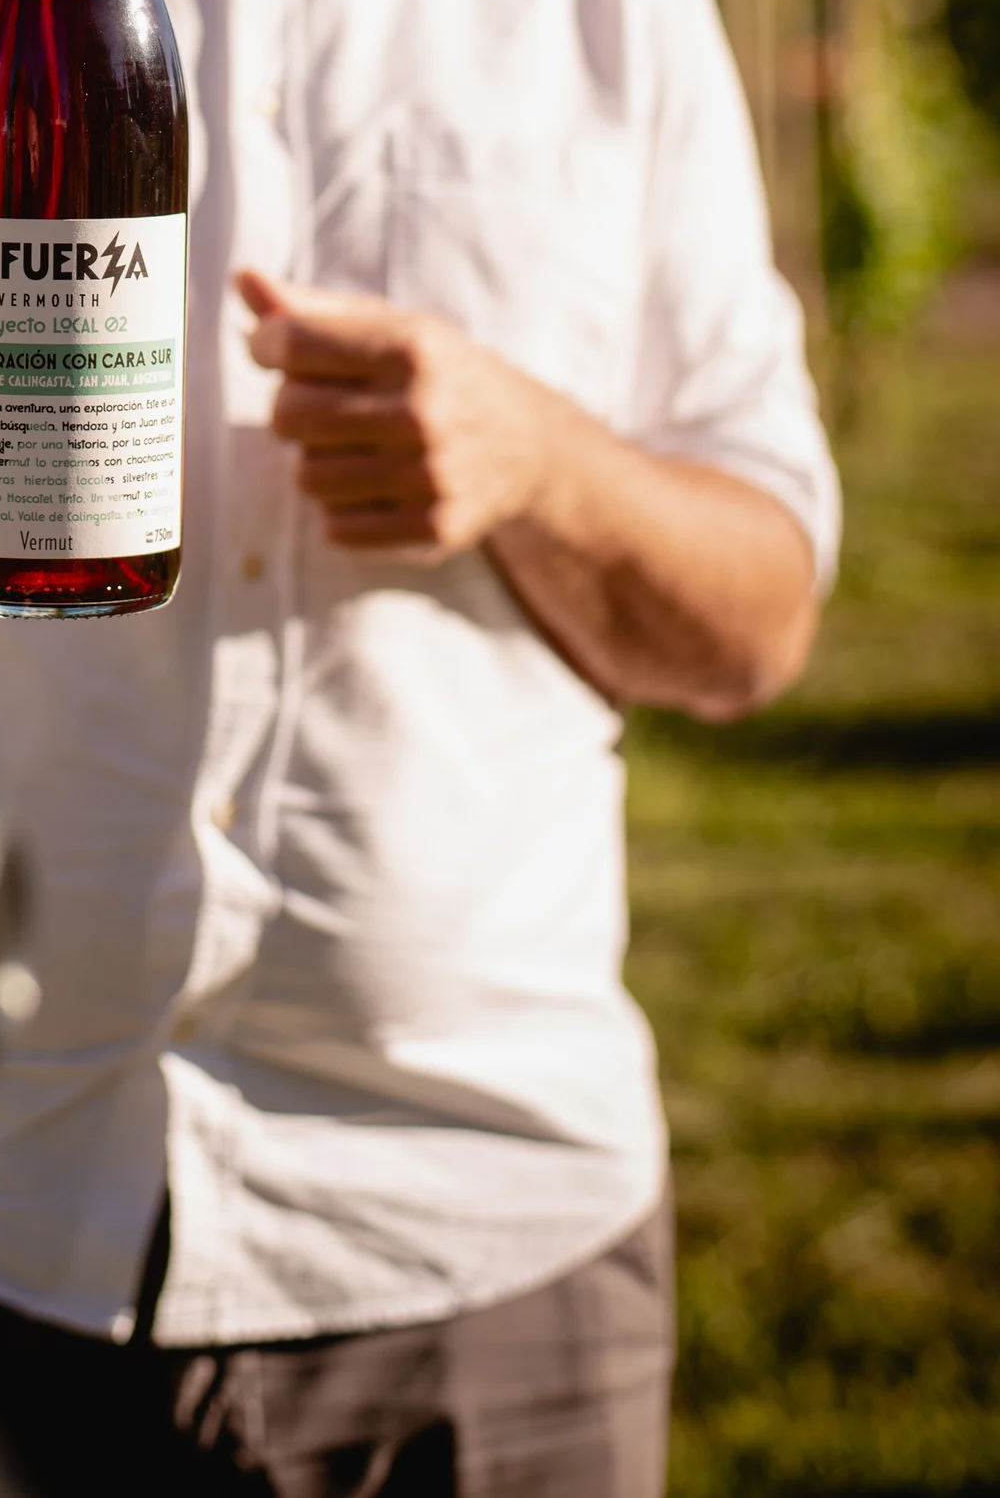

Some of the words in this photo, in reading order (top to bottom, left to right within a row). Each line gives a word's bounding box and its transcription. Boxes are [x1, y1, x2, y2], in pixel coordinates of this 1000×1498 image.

[53, 316, 100, 334] LOCAL
[62, 353, 97, 370] CON
[102, 350, 147, 369] CARA
[150, 348, 172, 365] SUR
[8, 375, 76, 389] CALINGASTA,
[79, 375, 98, 388] SAN
[5, 403, 56, 414] aventura,
[59, 405, 81, 413] una
[84, 401, 144, 416] exploración.
[0, 420, 58, 434] búsqueda.
[62, 421, 108, 431] Mendoza
[112, 422, 118, 434] y
[121, 420, 136, 429] San
[139, 418, 158, 428] Juan
[17, 440, 37, 451] por
[41, 441, 63, 449] una
[67, 439, 108, 450] historia,
[112, 440, 129, 451] por
[132, 437, 141, 446] la
[36, 458, 47, 468] lo
[51, 458, 100, 468] creamos
[104, 458, 123, 466] con
[24, 475, 67, 486] hierbas
[76, 474, 114, 486] locales
[122, 472, 158, 483] silvestres
[7, 493, 53, 504] Moscatel
[91, 493, 103, 503] Un
[108, 490, 140, 502] vermut
[18, 511, 45, 522] Valle
[49, 512, 63, 522] de
[20, 530, 73, 551] Vermut
